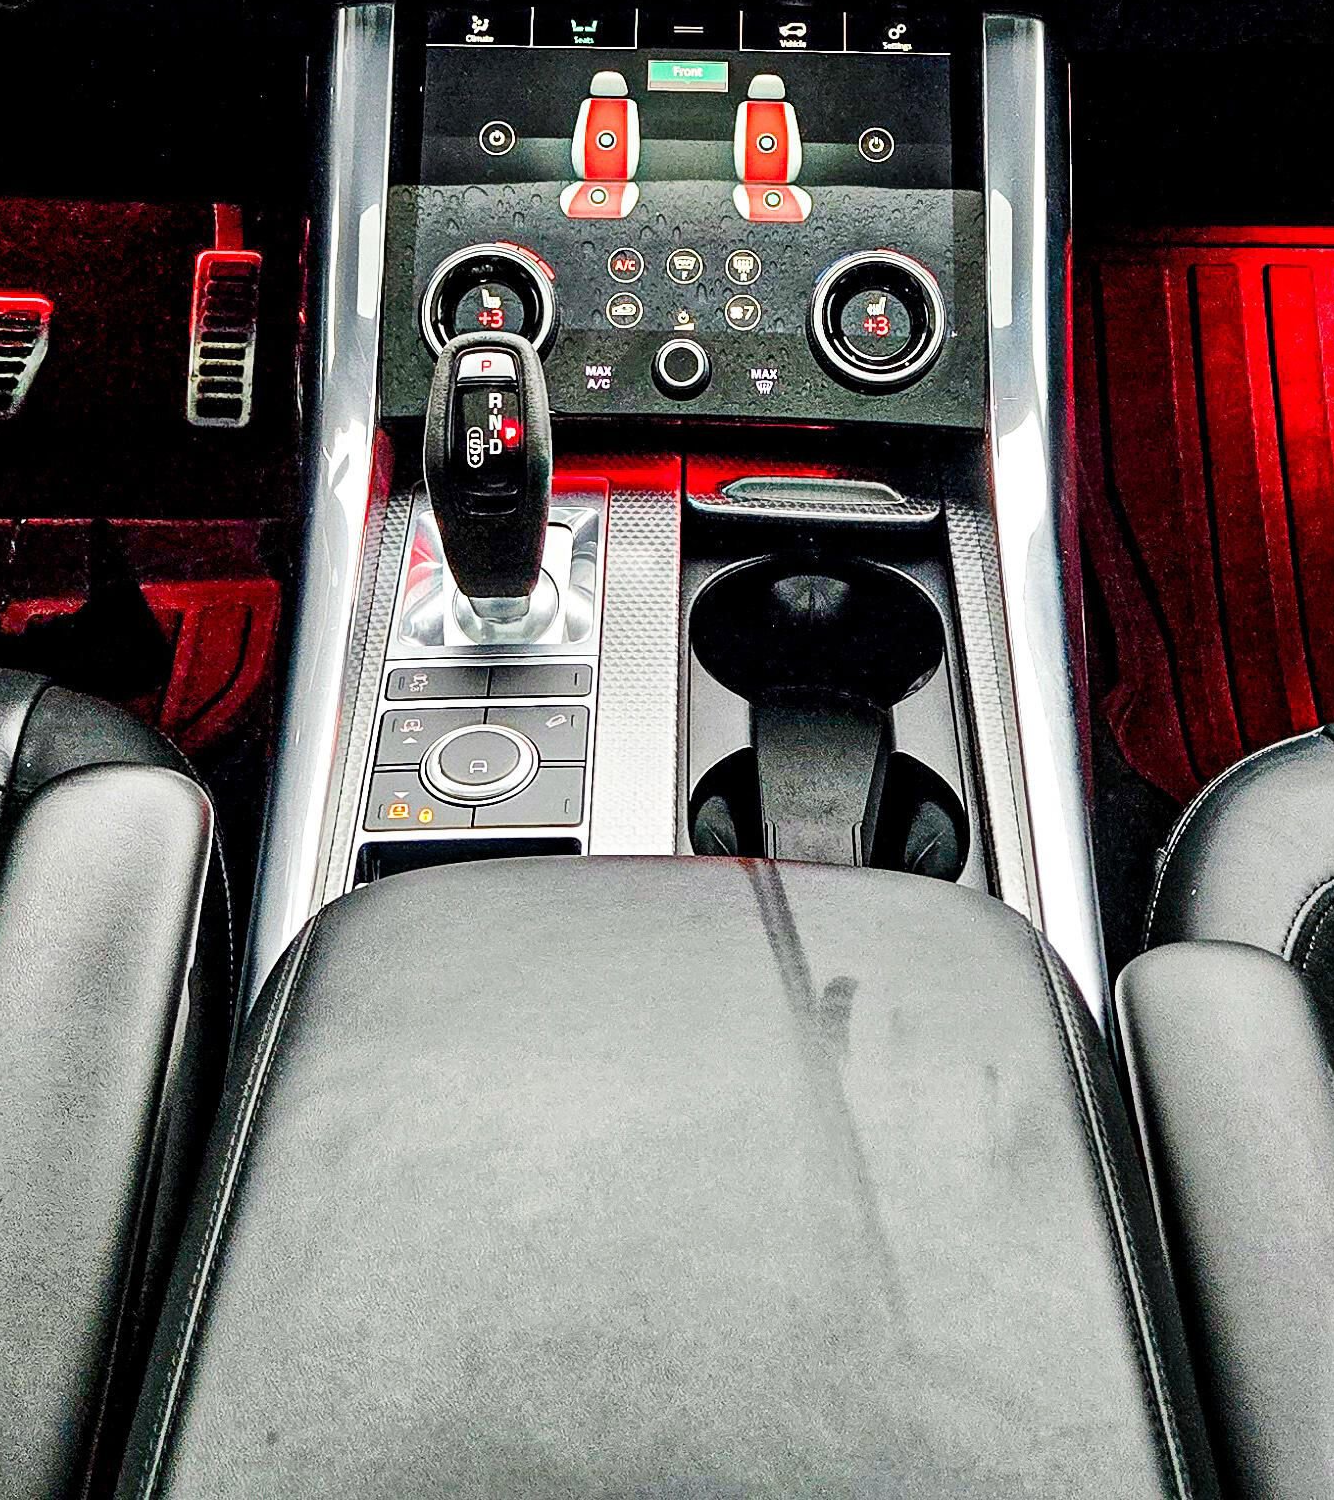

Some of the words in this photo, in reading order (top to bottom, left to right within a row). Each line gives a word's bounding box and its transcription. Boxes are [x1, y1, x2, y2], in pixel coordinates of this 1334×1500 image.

[465, 34, 495, 44] Climate
[573, 35, 594, 45] Seats
[779, 39, 807, 49] Vehicle
[882, 41, 913, 52] Settings
[672, 66, 704, 78] Front
[614, 259, 636, 272] A/C
[481, 360, 492, 373] P
[585, 365, 612, 377] MAX
[750, 368, 779, 380] MAX
[587, 378, 611, 390] A/C
[488, 392, 502, 409] R
[488, 414, 502, 431] N
[489, 439, 503, 455] D
